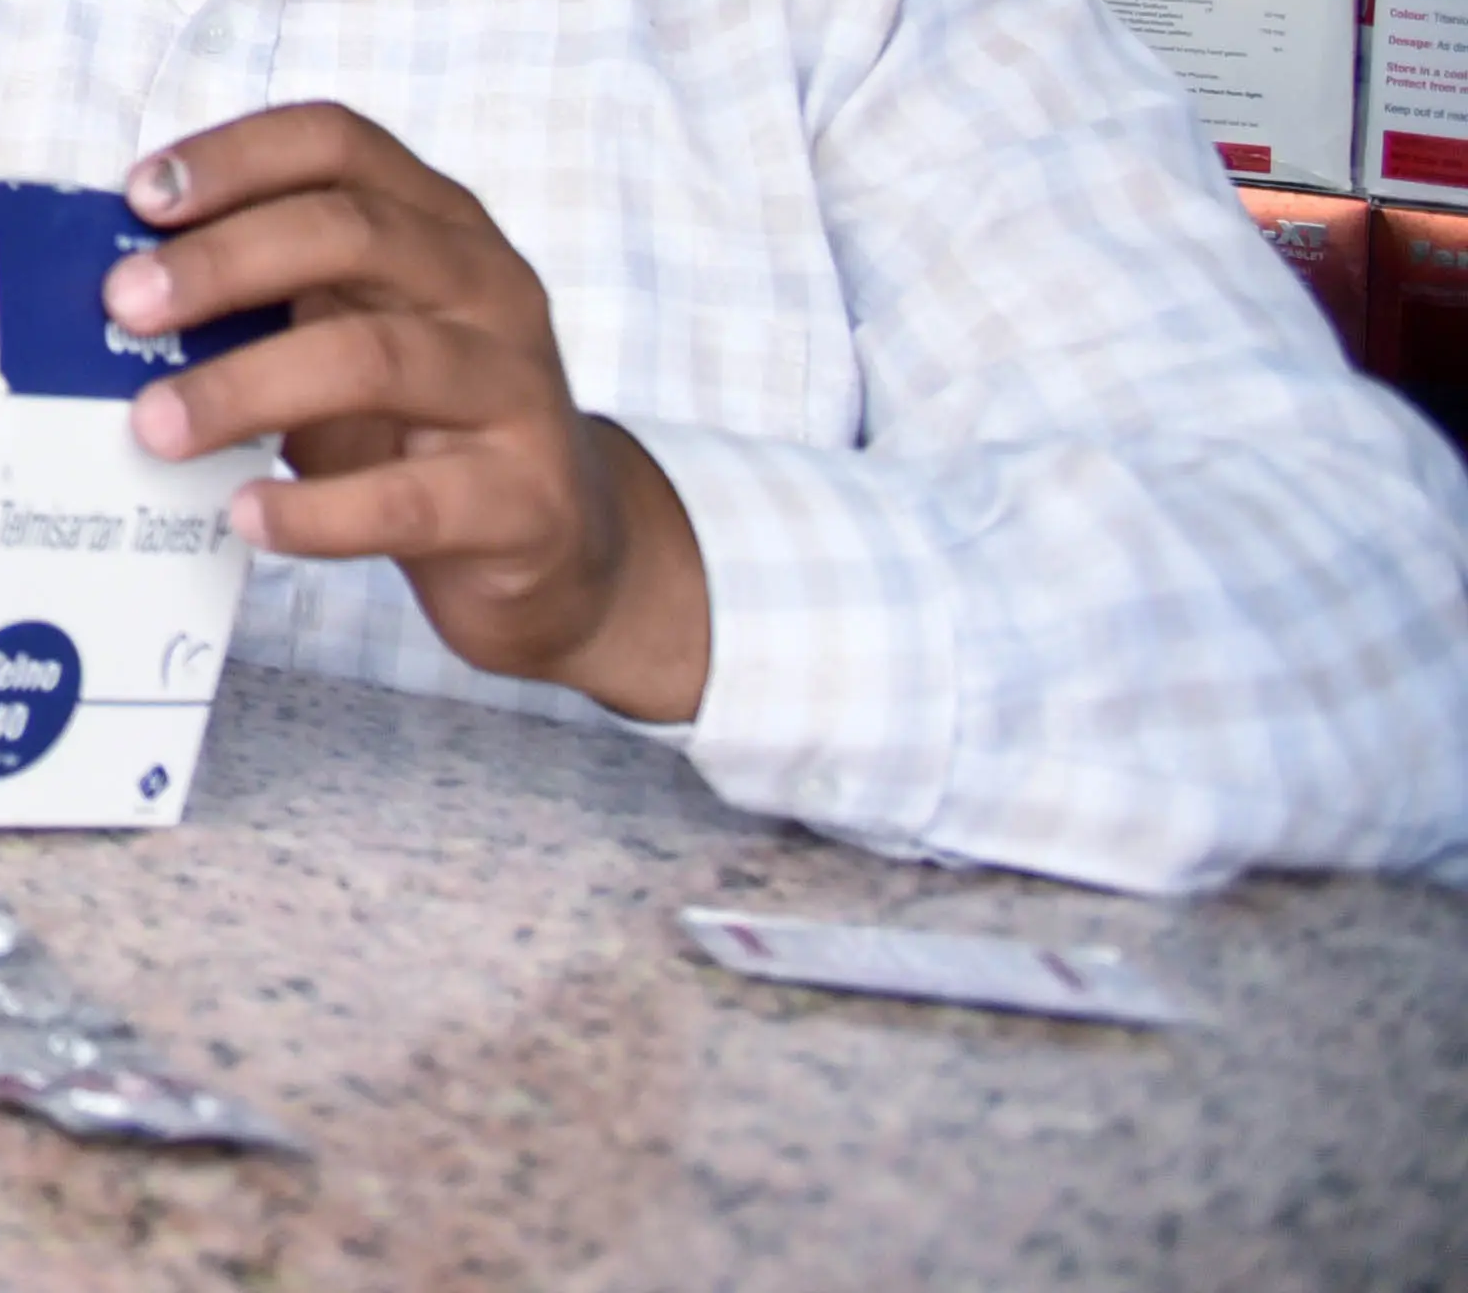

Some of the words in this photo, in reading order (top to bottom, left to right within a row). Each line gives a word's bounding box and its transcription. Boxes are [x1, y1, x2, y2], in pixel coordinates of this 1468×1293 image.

[1389, 8, 1429, 21] Colour:
[1388, 35, 1432, 49] Dosage:
[1386, 62, 1417, 75] Store
[1386, 76, 1427, 89] Protect
[1429, 79, 1456, 92] from
[1384, 102, 1411, 116] Keep
[1414, 107, 1430, 118] out
